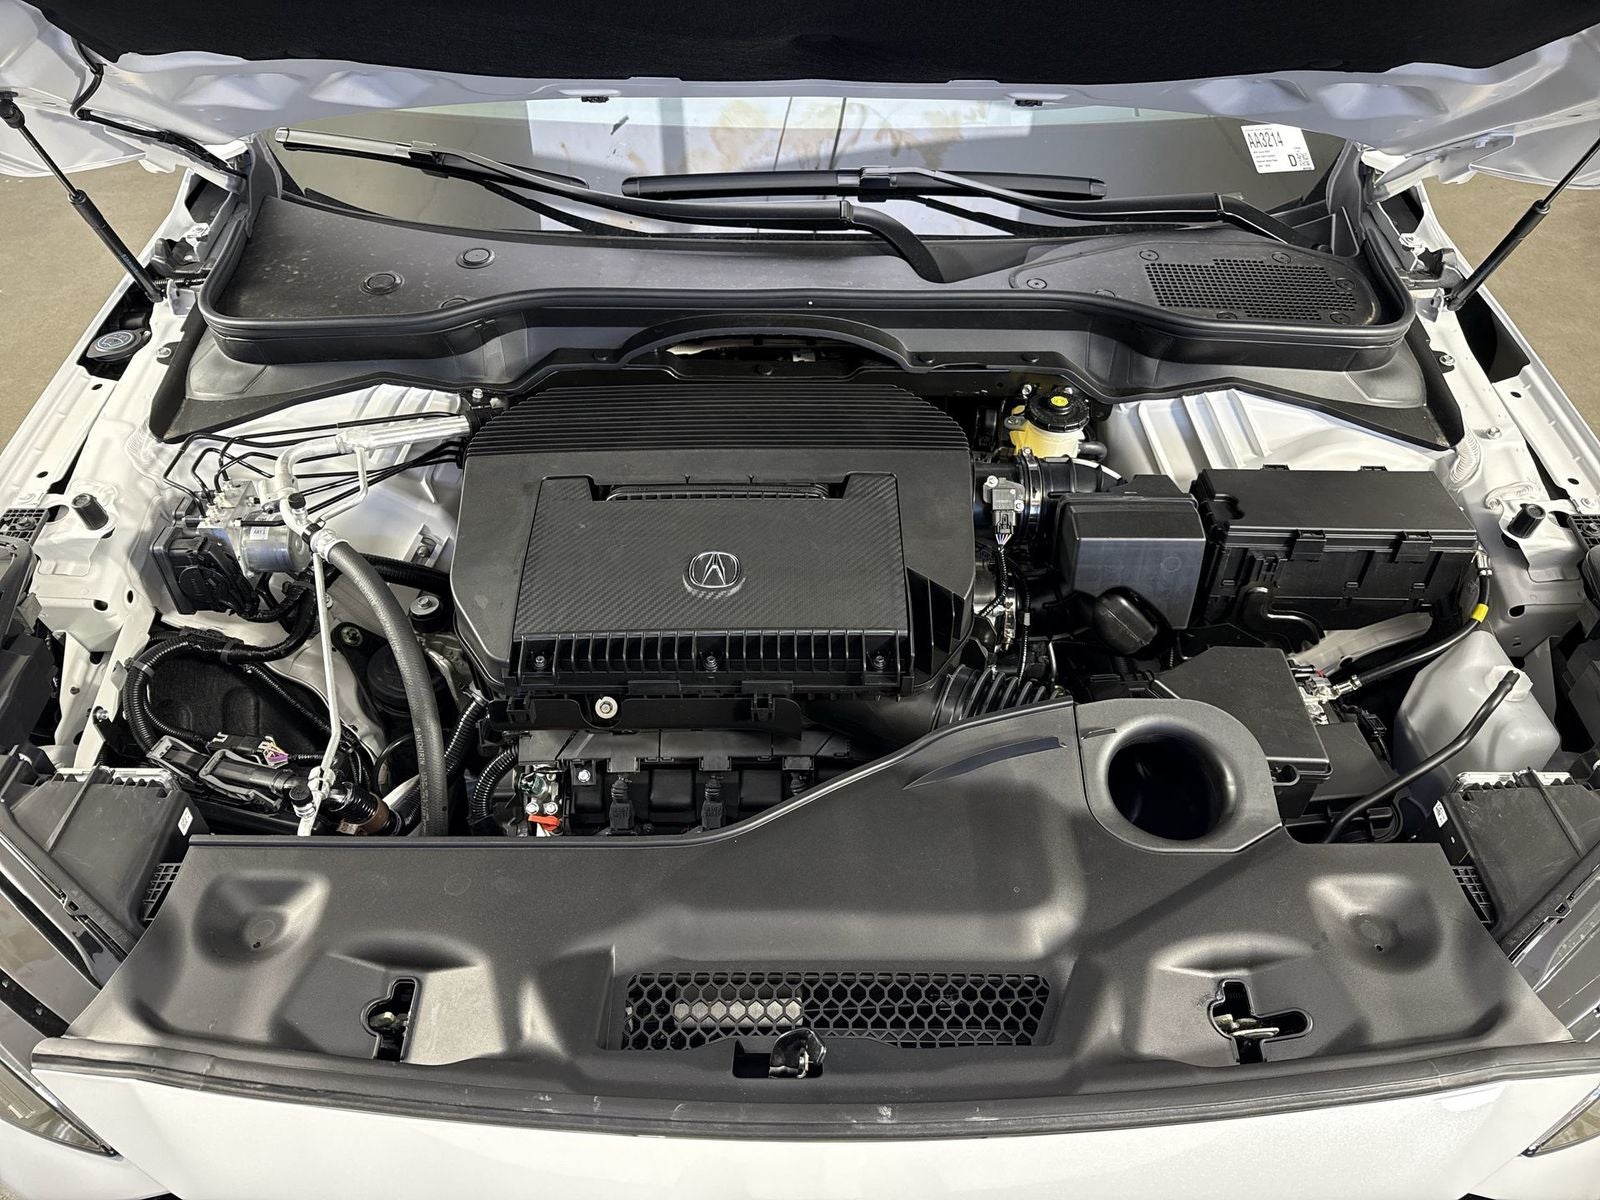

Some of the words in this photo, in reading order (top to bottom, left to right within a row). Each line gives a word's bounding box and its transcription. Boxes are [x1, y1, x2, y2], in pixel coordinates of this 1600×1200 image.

[1247, 131, 1284, 148] AA3214
[1288, 154, 1298, 167] D
[416, 734, 426, 765] NICHIRIN
